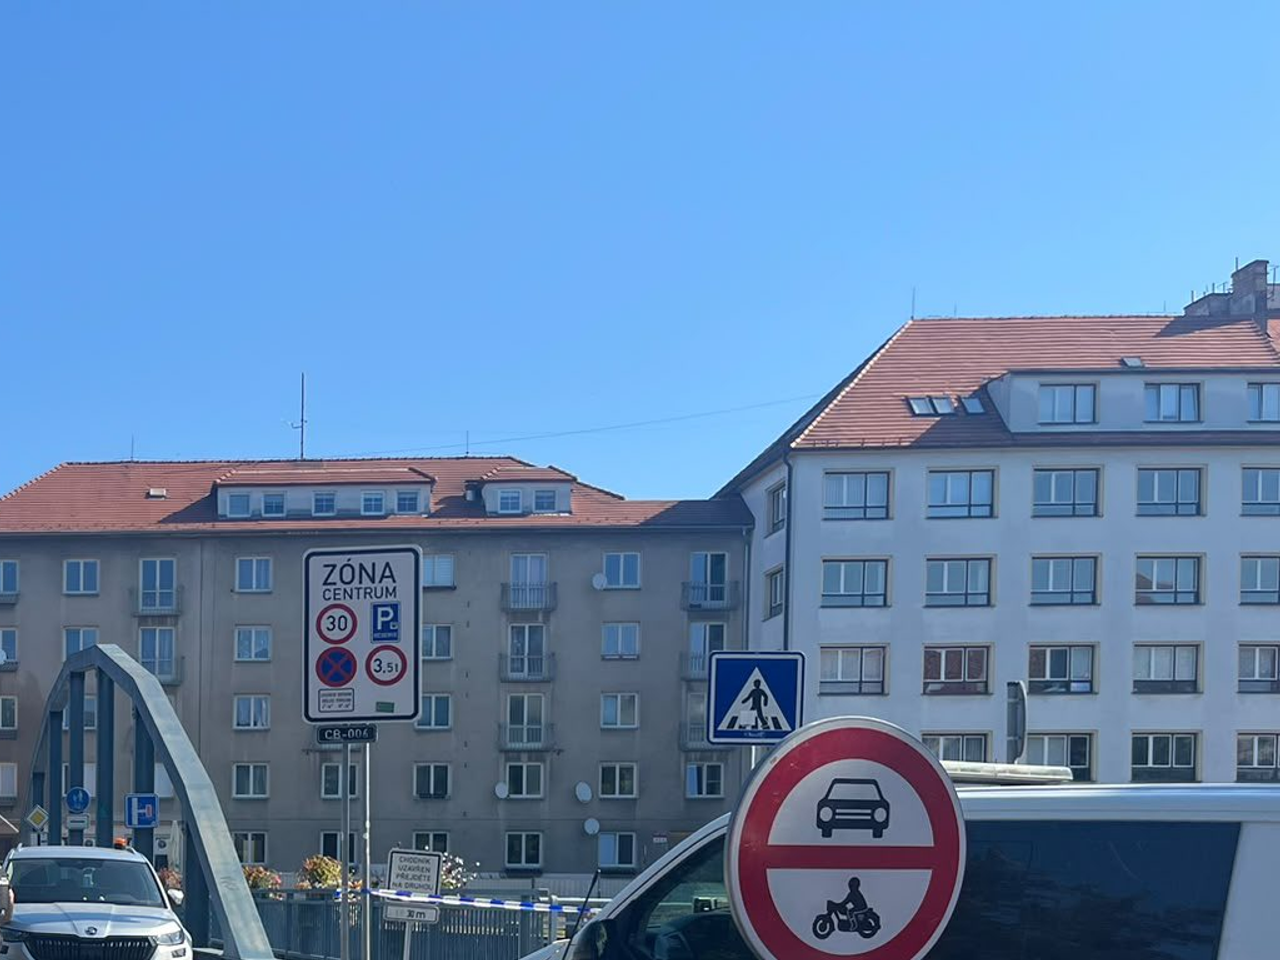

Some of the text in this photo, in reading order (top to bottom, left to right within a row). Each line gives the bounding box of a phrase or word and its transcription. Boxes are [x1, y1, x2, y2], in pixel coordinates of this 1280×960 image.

[323, 558, 397, 586] ZÓNA
[322, 586, 397, 601] CENTRUM
[326, 615, 348, 632] 30
[377, 607, 394, 630] P
